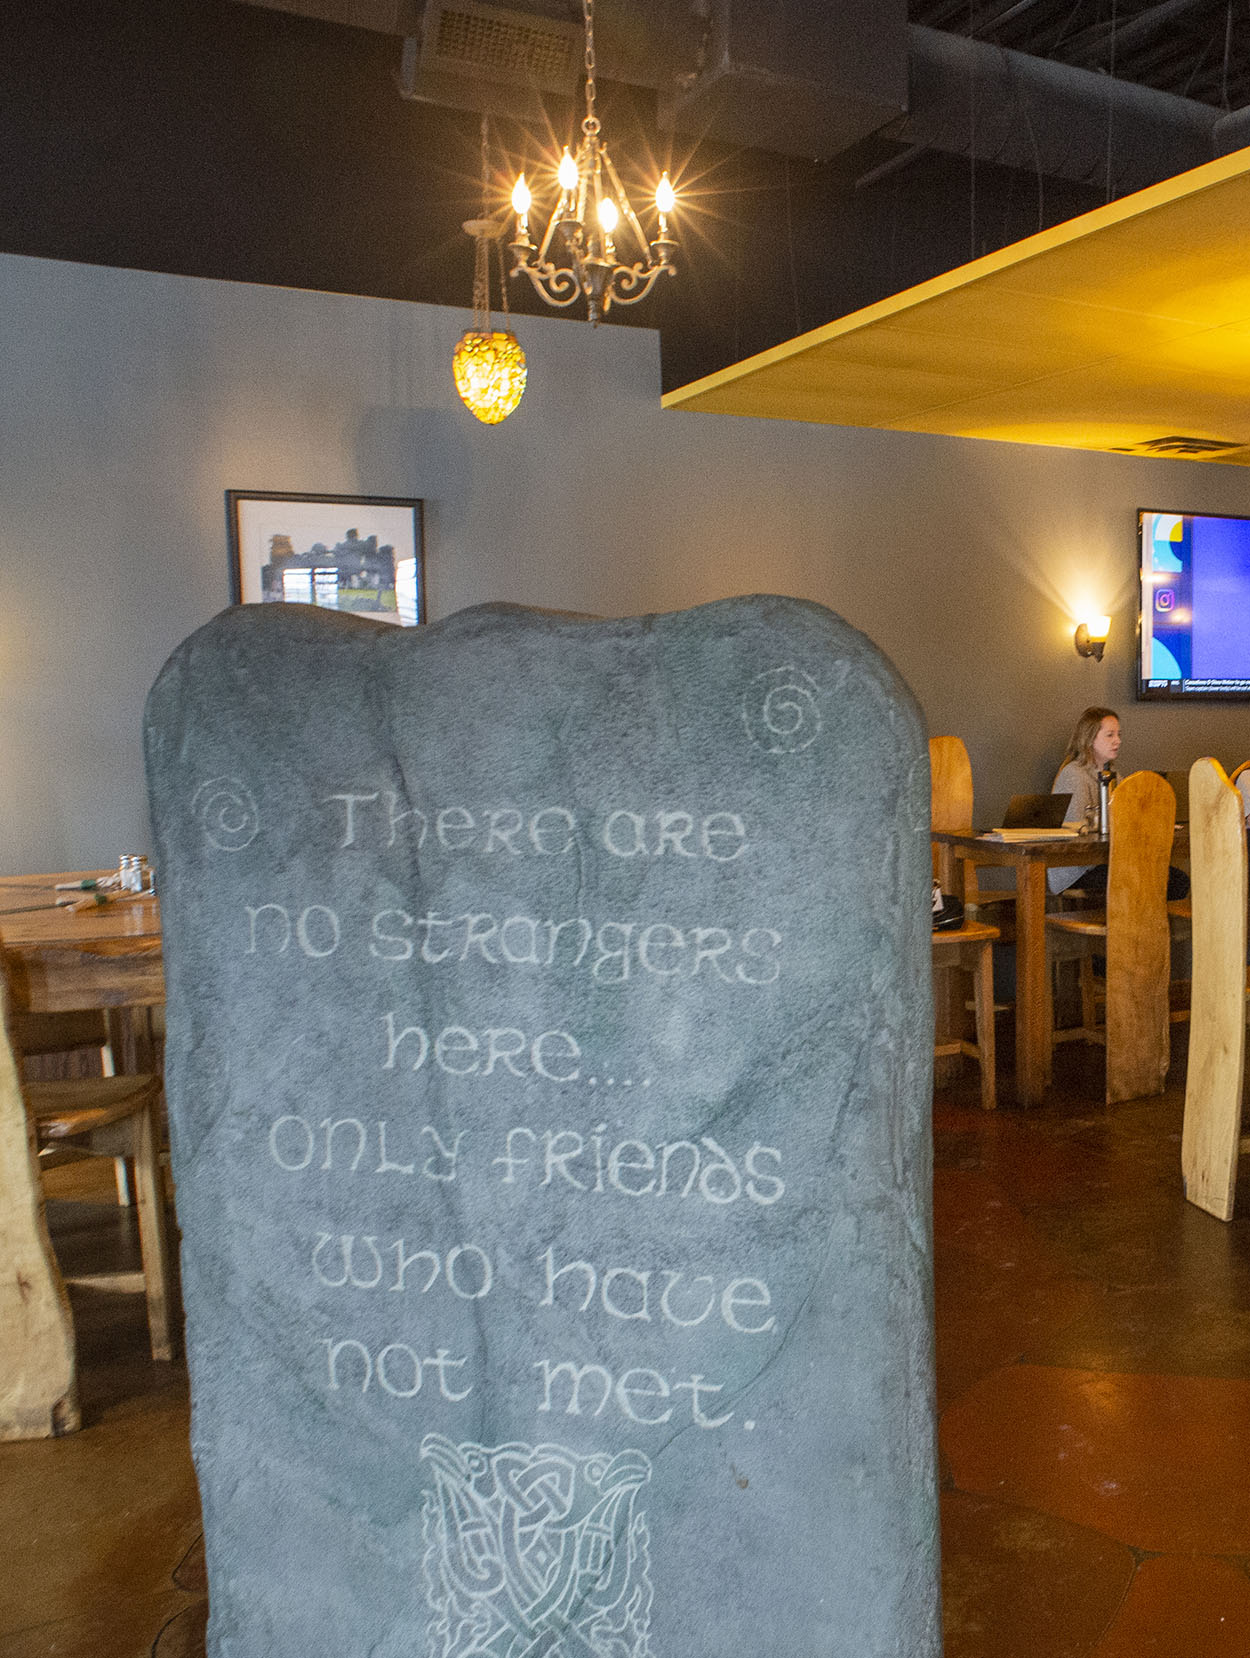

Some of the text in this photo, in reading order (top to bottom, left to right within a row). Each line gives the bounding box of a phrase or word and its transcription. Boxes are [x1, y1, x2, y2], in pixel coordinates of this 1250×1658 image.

[325, 793, 749, 861] There are
[244, 903, 782, 985] no strangers
[491, 1122, 784, 1203] friends
[311, 1231, 776, 1332] who have
[323, 1334, 756, 1431] not met.
